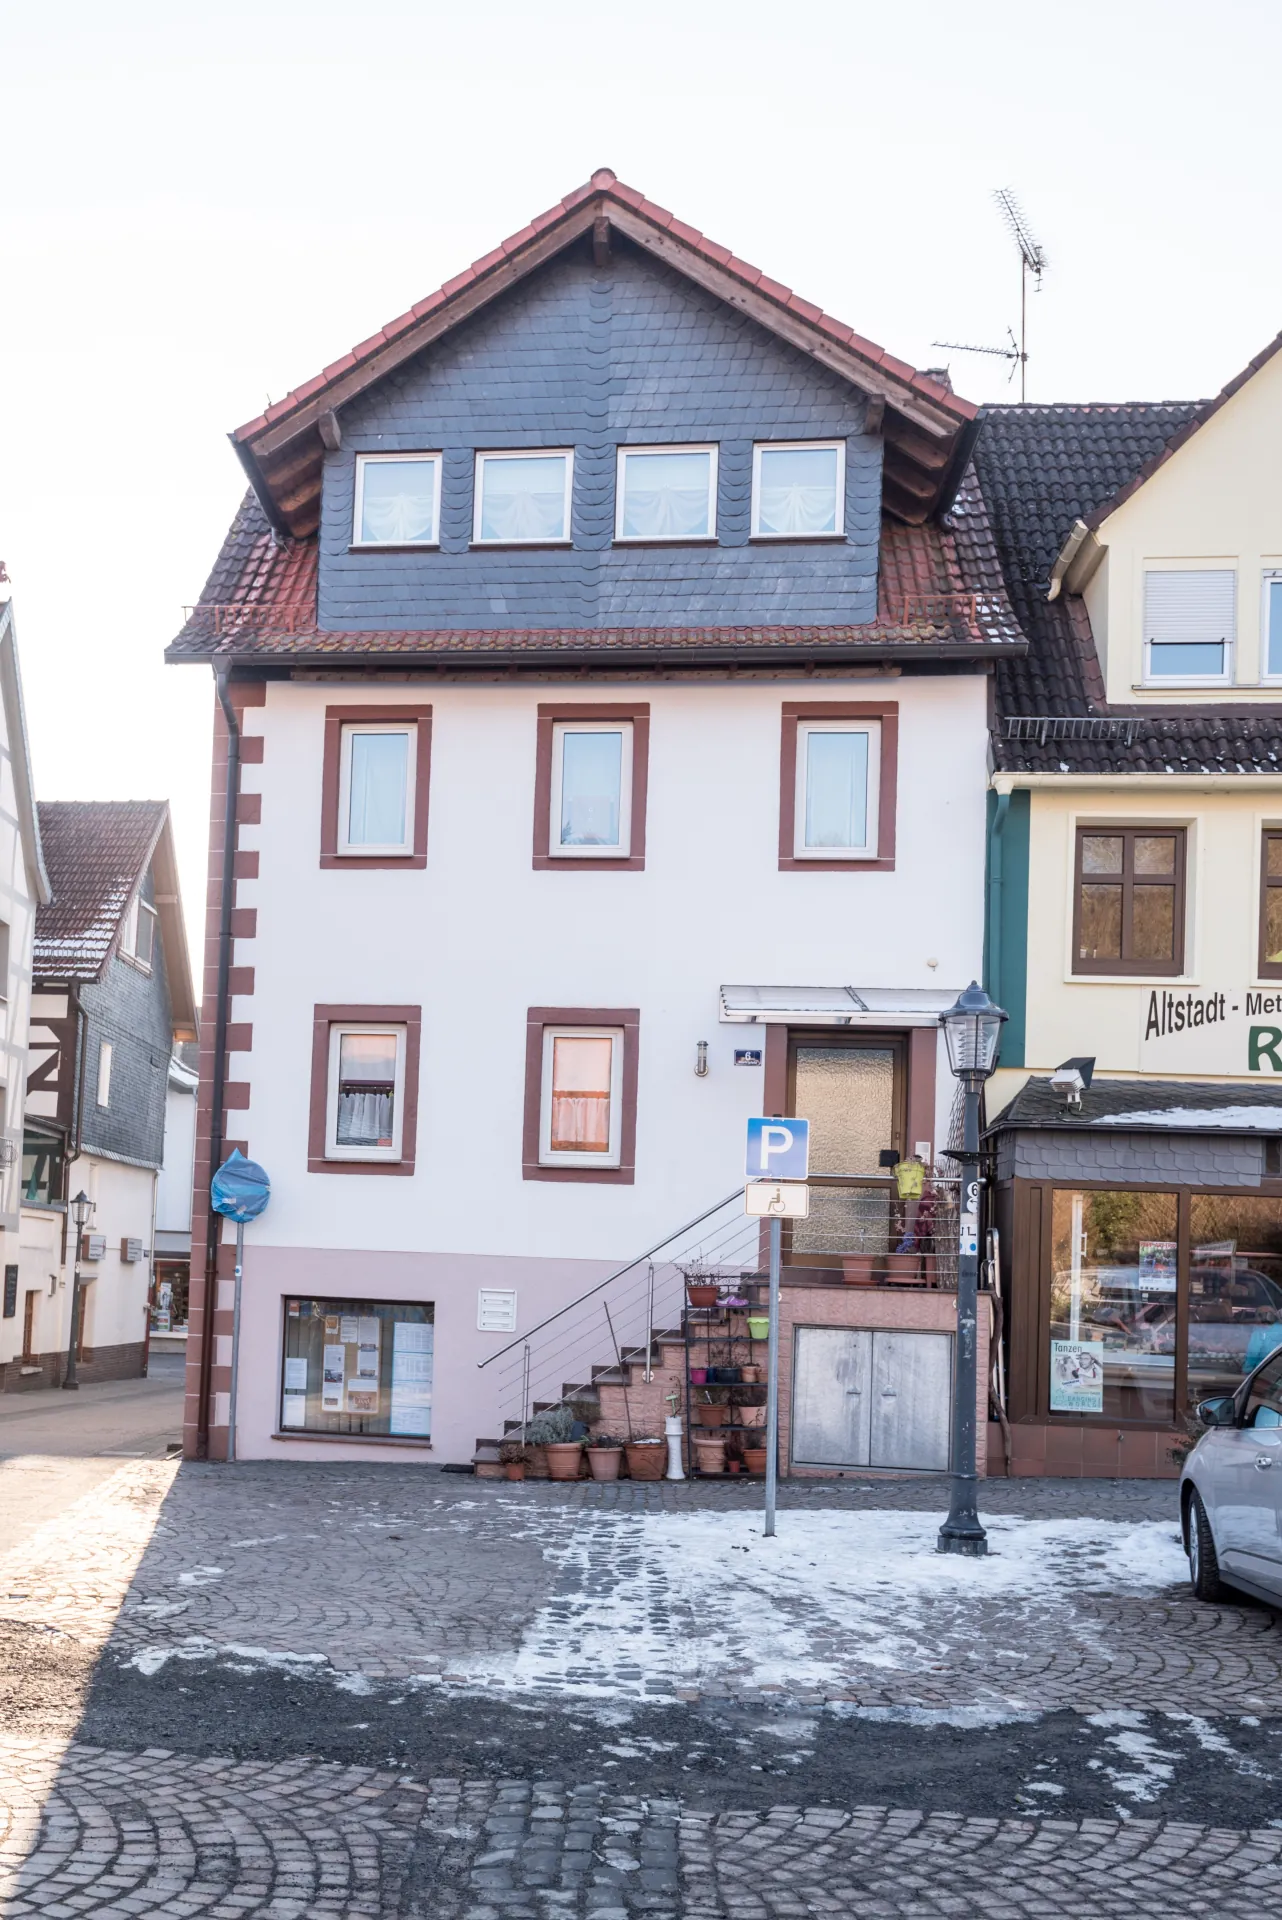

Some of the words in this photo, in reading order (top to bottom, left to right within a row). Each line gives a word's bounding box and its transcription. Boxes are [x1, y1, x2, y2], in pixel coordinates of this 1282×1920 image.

[1145, 990, 1226, 1041] Altstadt
[745, 1051, 752, 1061] 6
[1248, 1025, 1282, 1072] R
[760, 1125, 794, 1170] P
[971, 1183, 978, 1197] 6
[1054, 1342, 1083, 1353] Tanzen
